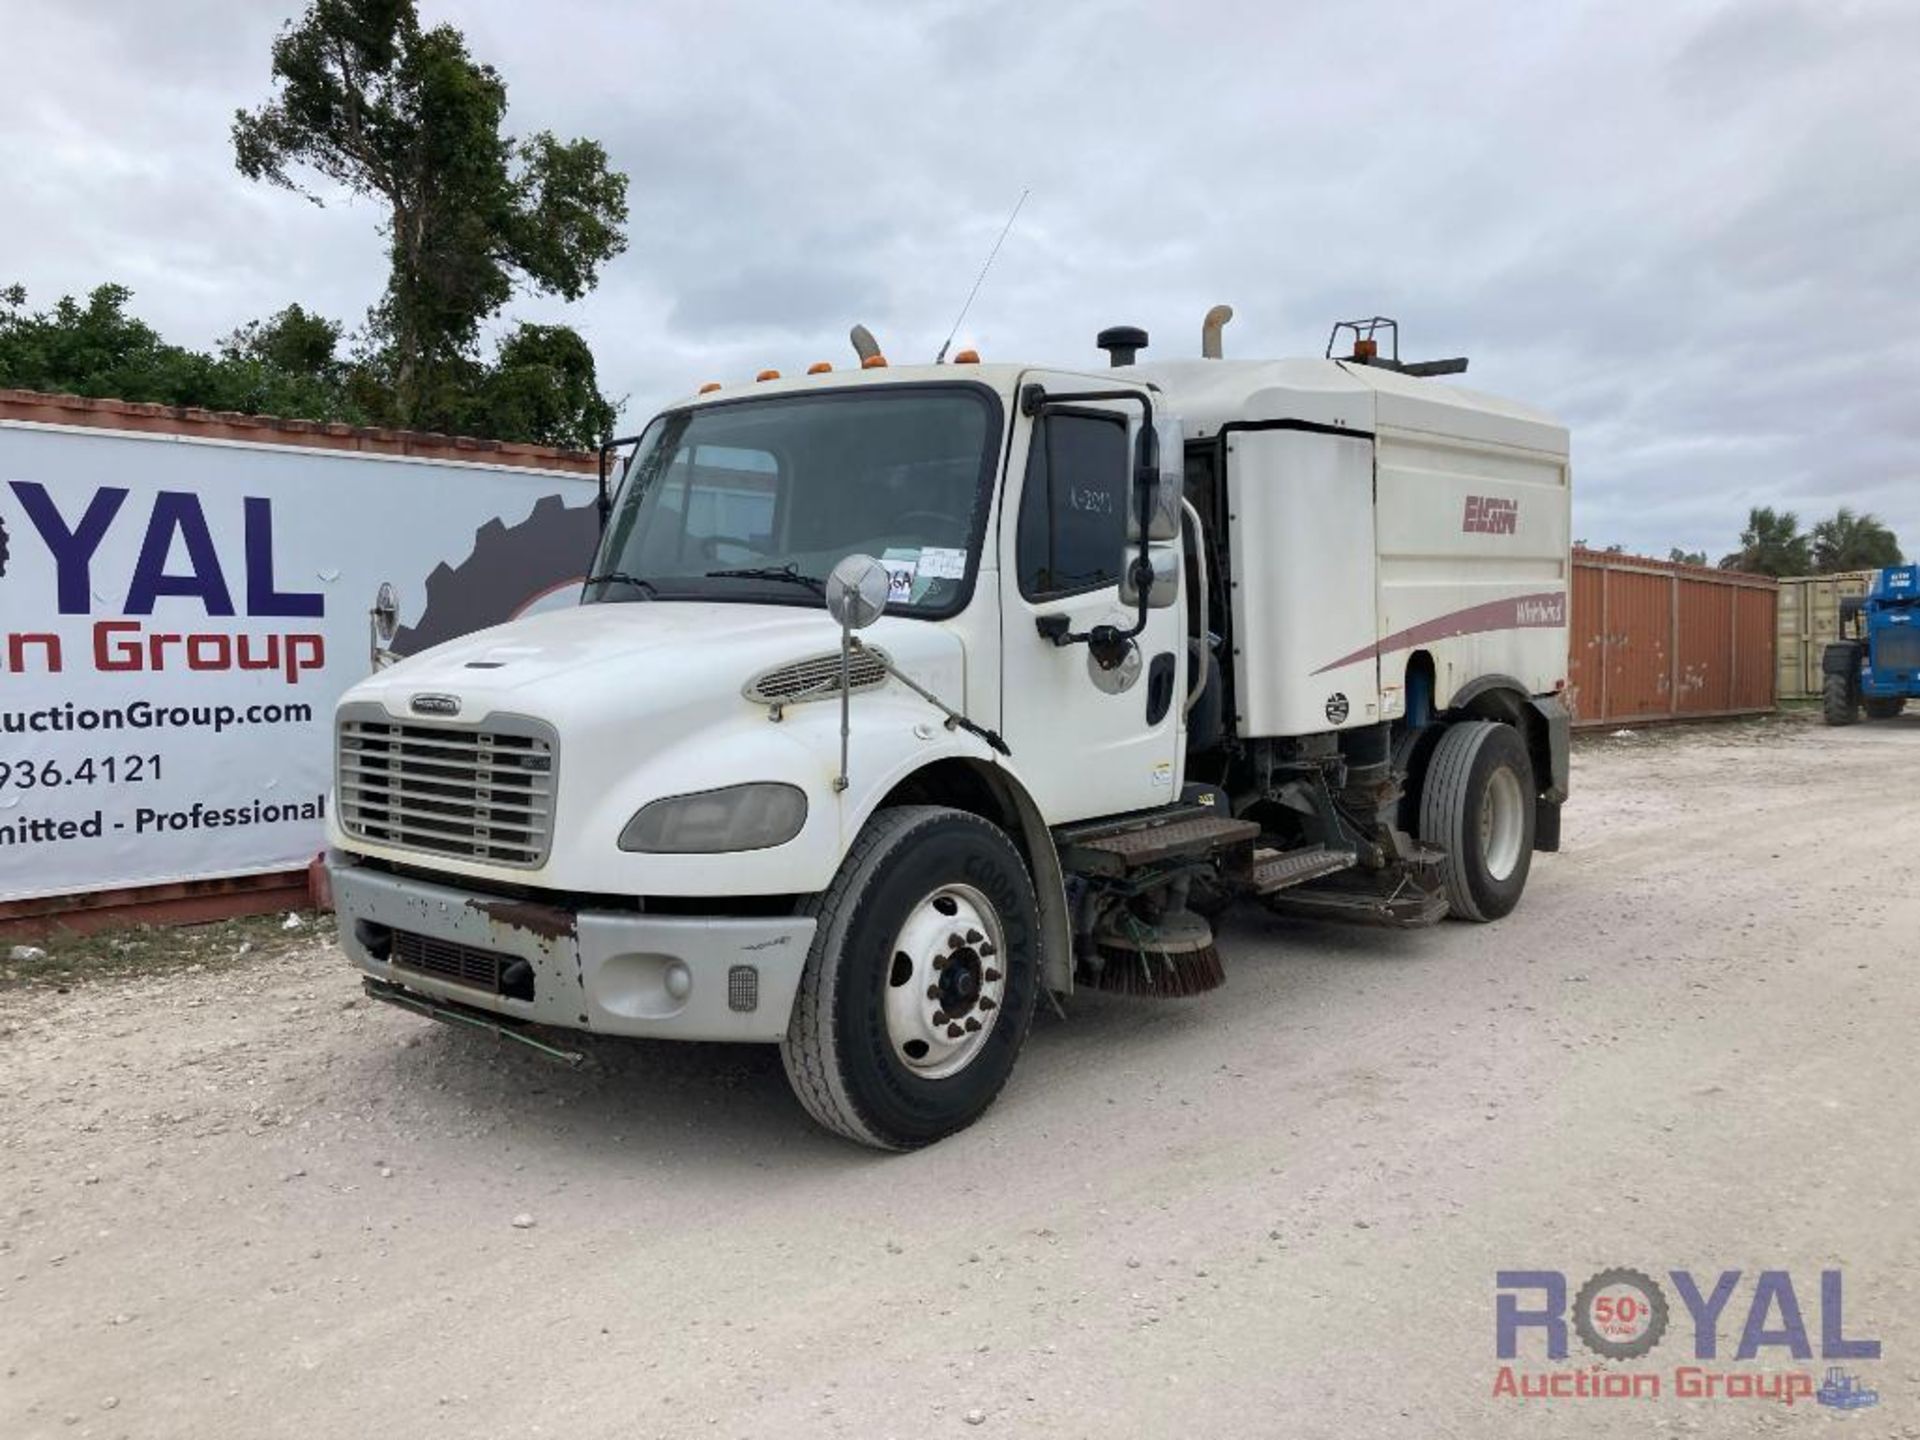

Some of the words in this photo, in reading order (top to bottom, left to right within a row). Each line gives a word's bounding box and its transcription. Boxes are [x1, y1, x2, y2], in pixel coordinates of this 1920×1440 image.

[0, 481, 325, 617] YAL
[93, 621, 325, 684] Group
[0, 701, 313, 733] uctionGroup.com
[136, 794, 325, 834] Professional
